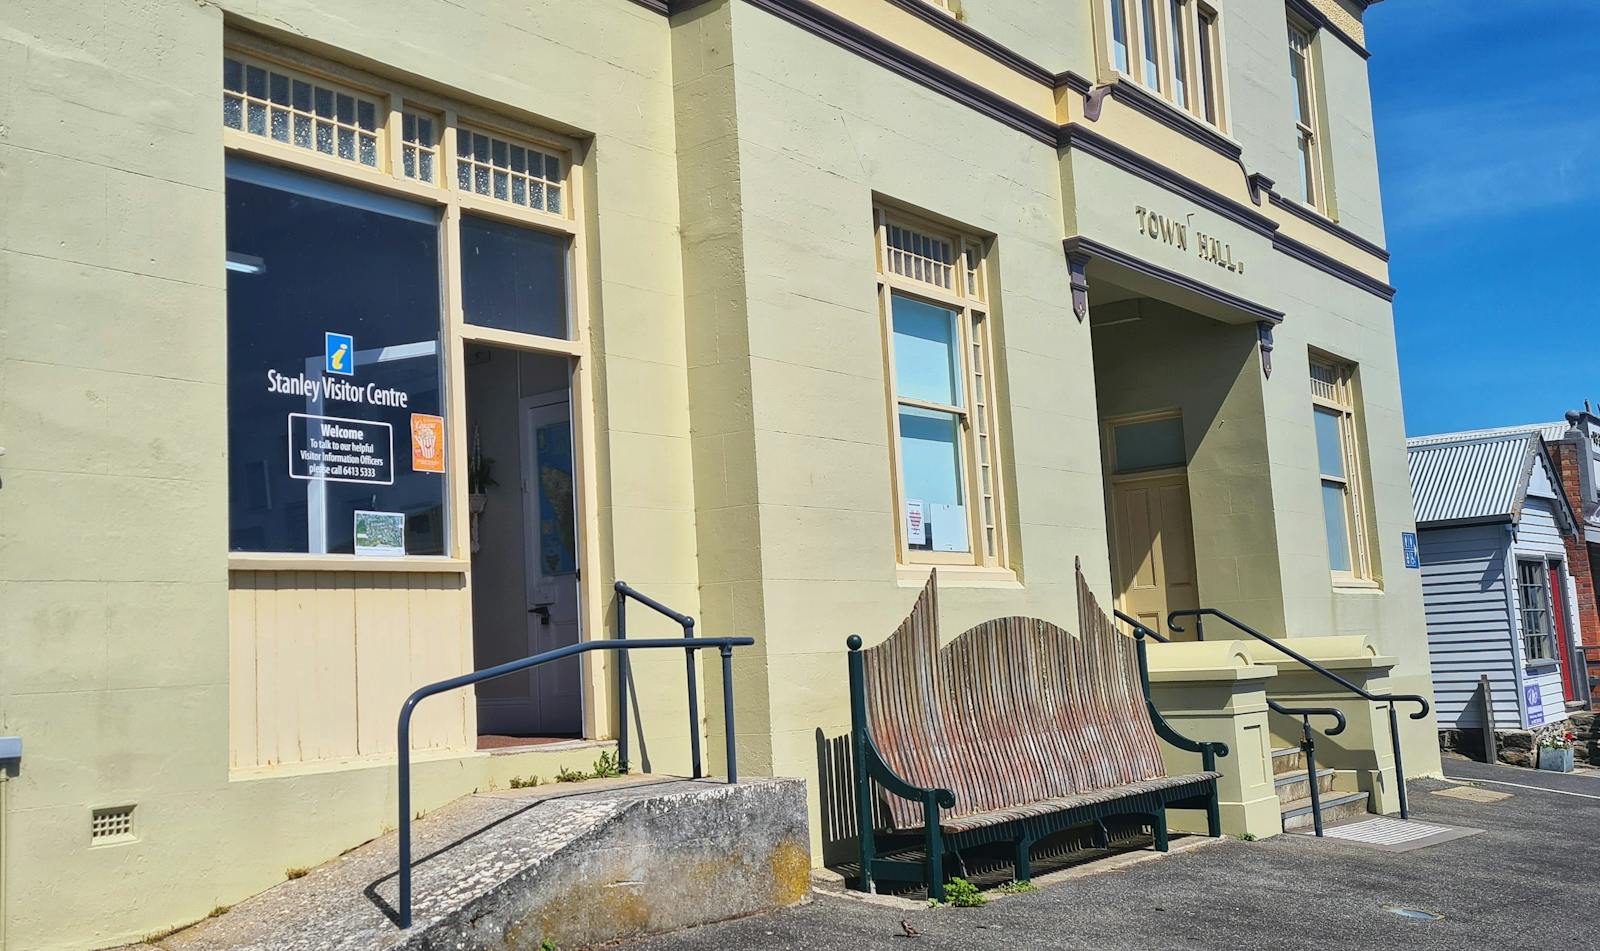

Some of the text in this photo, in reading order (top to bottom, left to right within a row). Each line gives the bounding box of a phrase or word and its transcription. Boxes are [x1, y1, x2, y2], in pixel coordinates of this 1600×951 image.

[1135, 205, 1187, 251] TOWN
[267, 369, 408, 408] Stanley Visitor Centre
[320, 424, 364, 440] Welcome
[310, 438, 374, 454] To talk to our helpful
[300, 450, 383, 466] Visitor Information Officers
[309, 464, 376, 478] please call 6413 5333
